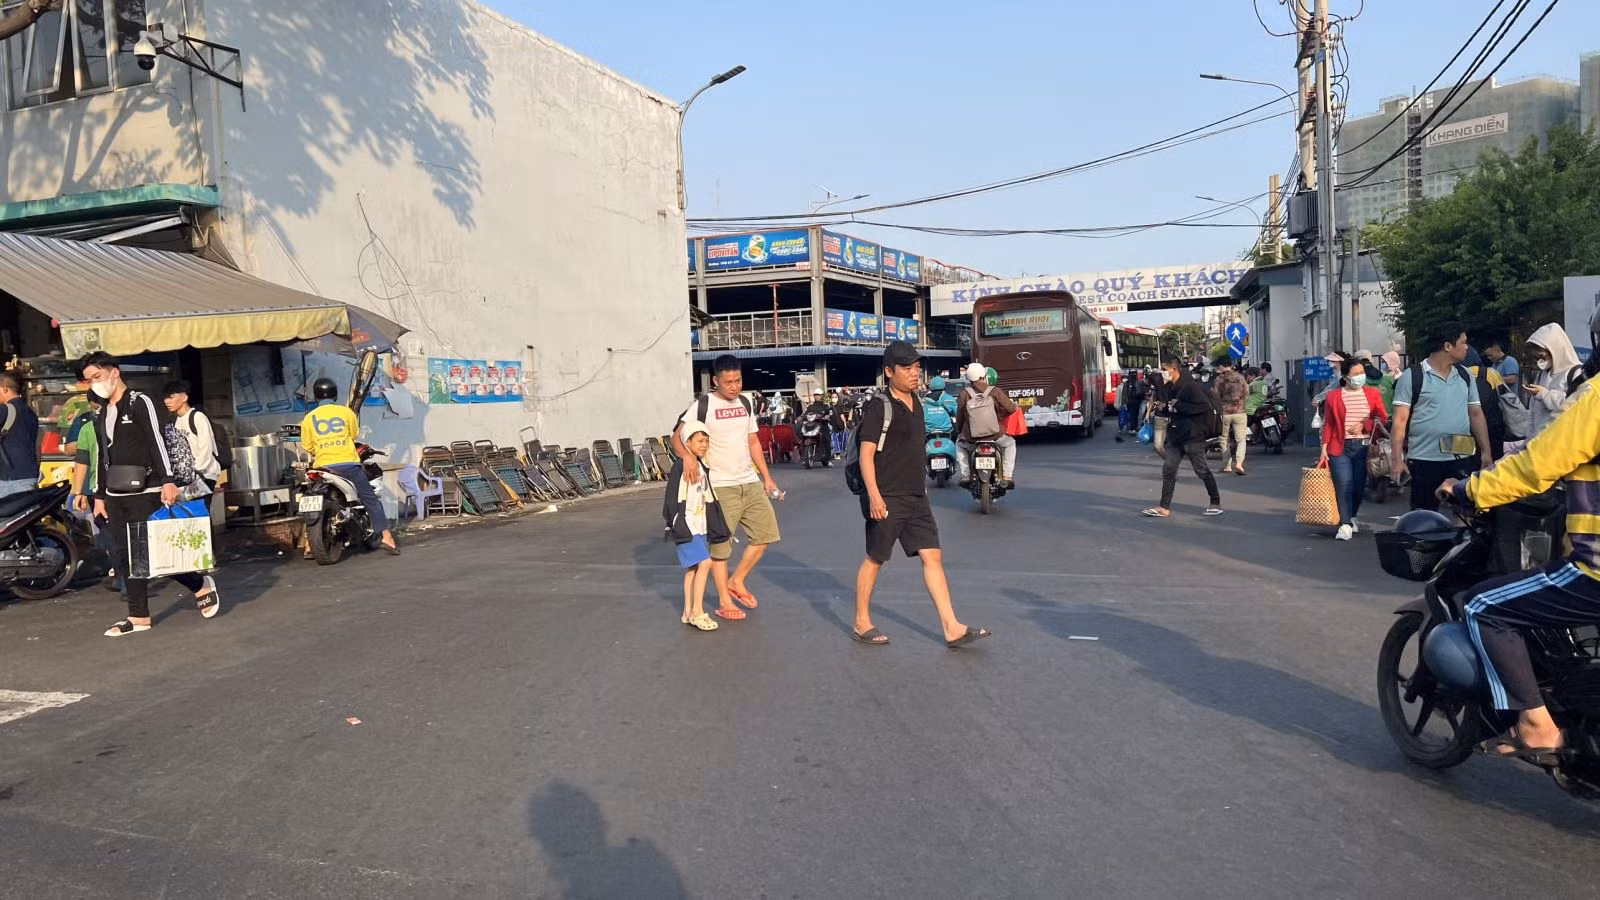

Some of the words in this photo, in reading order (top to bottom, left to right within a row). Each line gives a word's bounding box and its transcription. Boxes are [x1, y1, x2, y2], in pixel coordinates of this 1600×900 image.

[1429, 127, 1472, 142] KHANG
[1474, 116, 1505, 133] ĐIỀN
[709, 249, 738, 257] LIPOVITAN
[951, 284, 1012, 303] KÍNH
[1094, 272, 1145, 295] QUÝ
[1153, 267, 1247, 289] KHÁCH
[1079, 294, 1104, 304] EST
[1107, 290, 1156, 302] COACH
[1160, 286, 1225, 298] STATION
[312, 415, 346, 435] be
